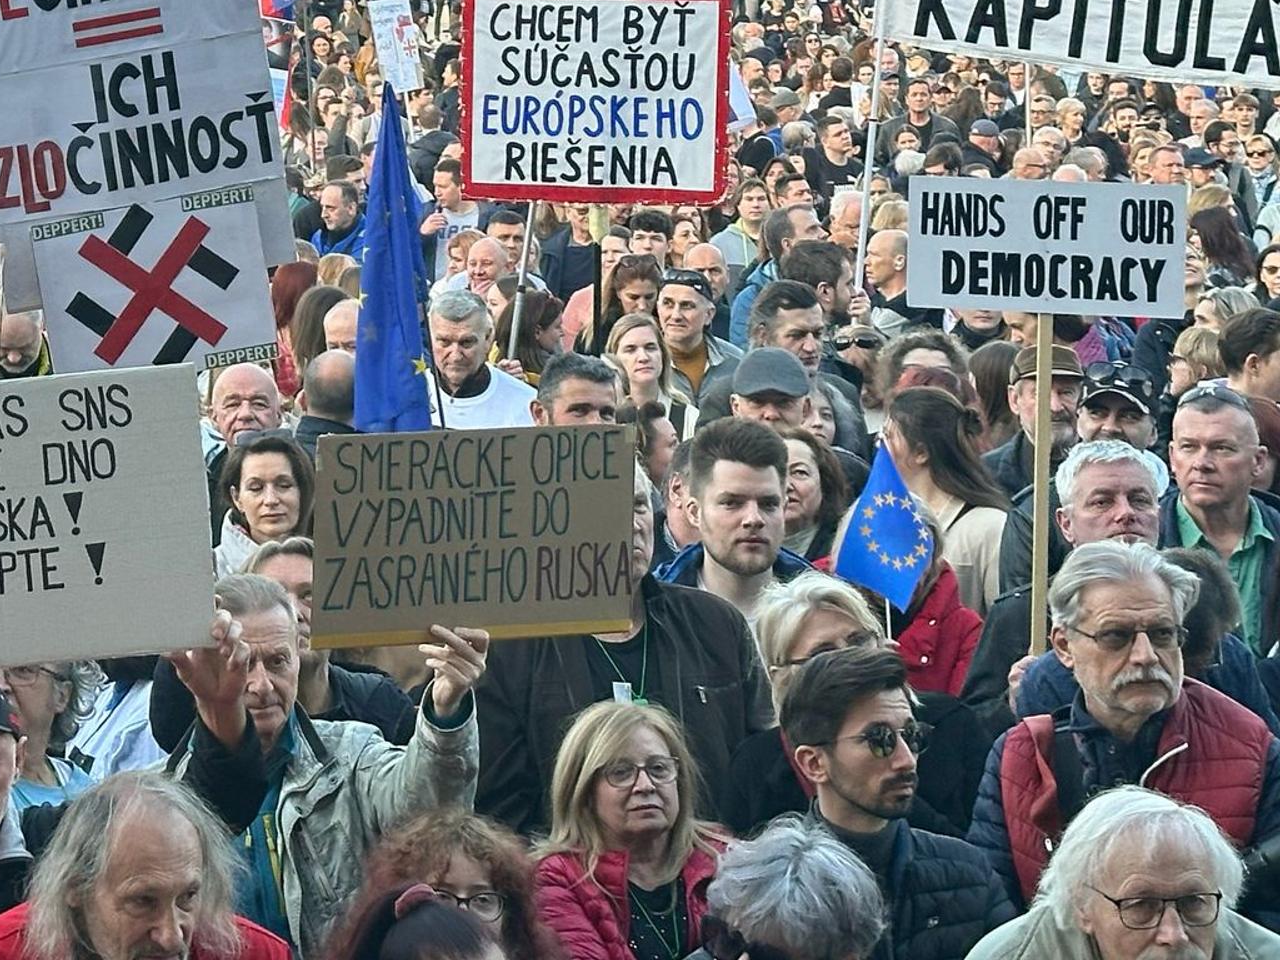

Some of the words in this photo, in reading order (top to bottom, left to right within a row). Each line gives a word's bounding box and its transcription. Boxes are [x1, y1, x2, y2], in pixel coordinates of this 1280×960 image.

[490, 3, 599, 43] CHCEM
[622, 0, 695, 47] BYŤ
[90, 51, 181, 124] ICH
[497, 43, 696, 91] SÚČASŤOU
[482, 90, 704, 141] EURÓPSKEHO
[505, 137, 678, 186] RIEŠENIA
[182, 188, 254, 211] DEPPERT!
[921, 192, 1006, 238] HANDS
[1033, 194, 1087, 240] OFF
[1120, 198, 1174, 244] OUR
[32, 214, 104, 240] DEPPERT!
[941, 250, 1167, 303] DEMOCRACY
[207, 344, 278, 368] DEPPERT!
[58, 383, 133, 431] SNS
[42, 438, 116, 486] DNO
[333, 435, 517, 495] SMERÁCKE
[532, 487, 570, 537] DO
[321, 543, 528, 611] ZASRANÉHO
[535, 541, 633, 601] RUSKA
